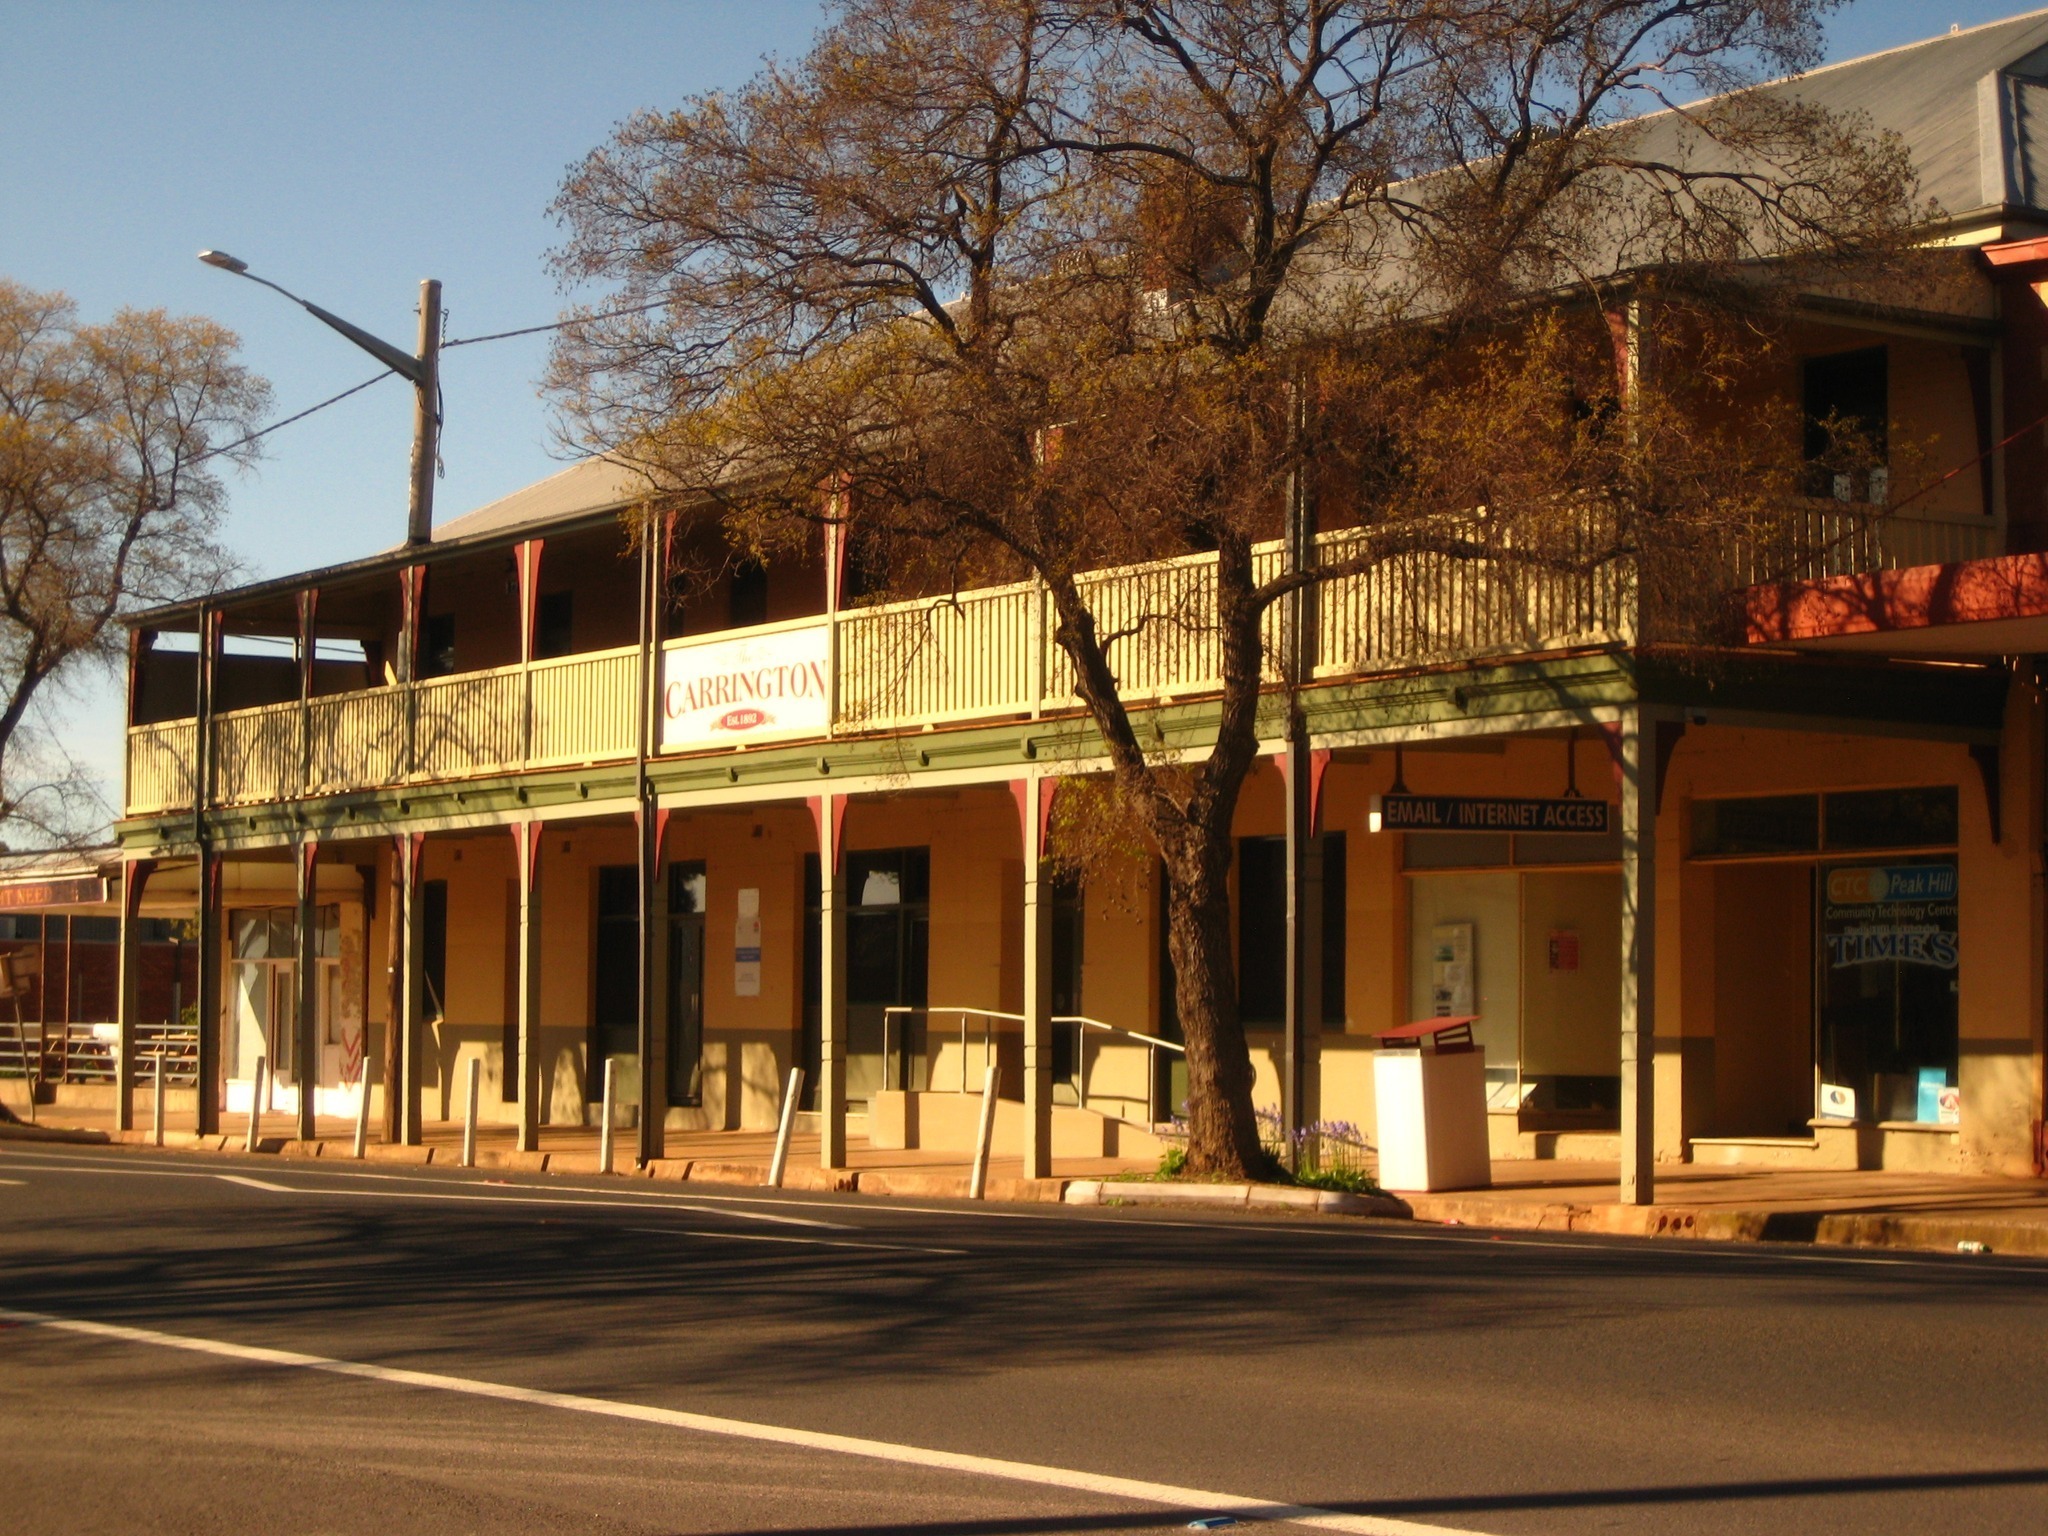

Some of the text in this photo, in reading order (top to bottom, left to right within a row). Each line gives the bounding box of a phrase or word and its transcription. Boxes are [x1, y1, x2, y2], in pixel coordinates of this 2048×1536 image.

[665, 659, 827, 719] CARRINGTON
[1387, 801, 1604, 828] EMAIL / INTERNET ACCESS
[16, 886, 53, 905] NEED
[1831, 876, 1866, 897] CTC
[1891, 873, 1924, 894] Peak
[1928, 871, 1954, 893] Hill
[1826, 906, 1876, 922] Community
[1878, 904, 1925, 922] Technology
[1826, 931, 1958, 970] TIMES
